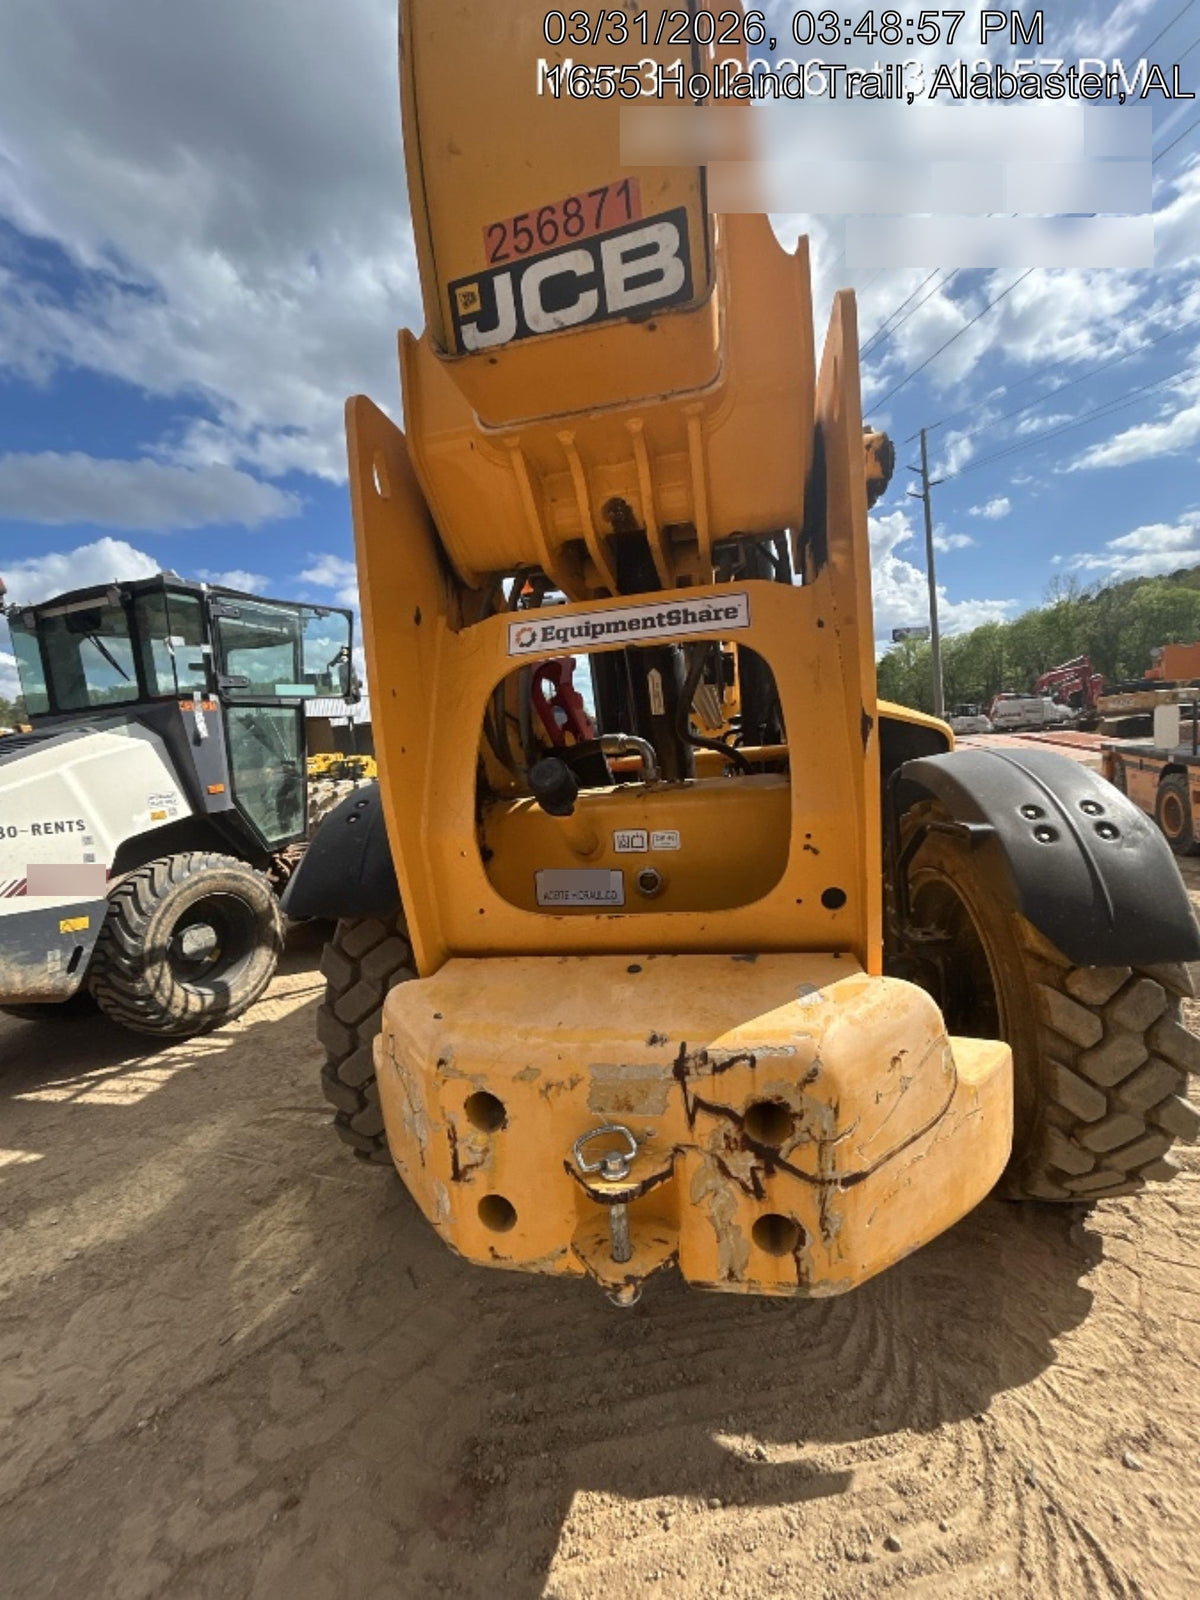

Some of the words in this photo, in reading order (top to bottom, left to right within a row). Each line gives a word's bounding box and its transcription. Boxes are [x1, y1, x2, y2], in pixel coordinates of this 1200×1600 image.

[486, 178, 633, 264] 256871
[460, 221, 686, 351] JCB
[540, 604, 738, 643] EquipmentShare
